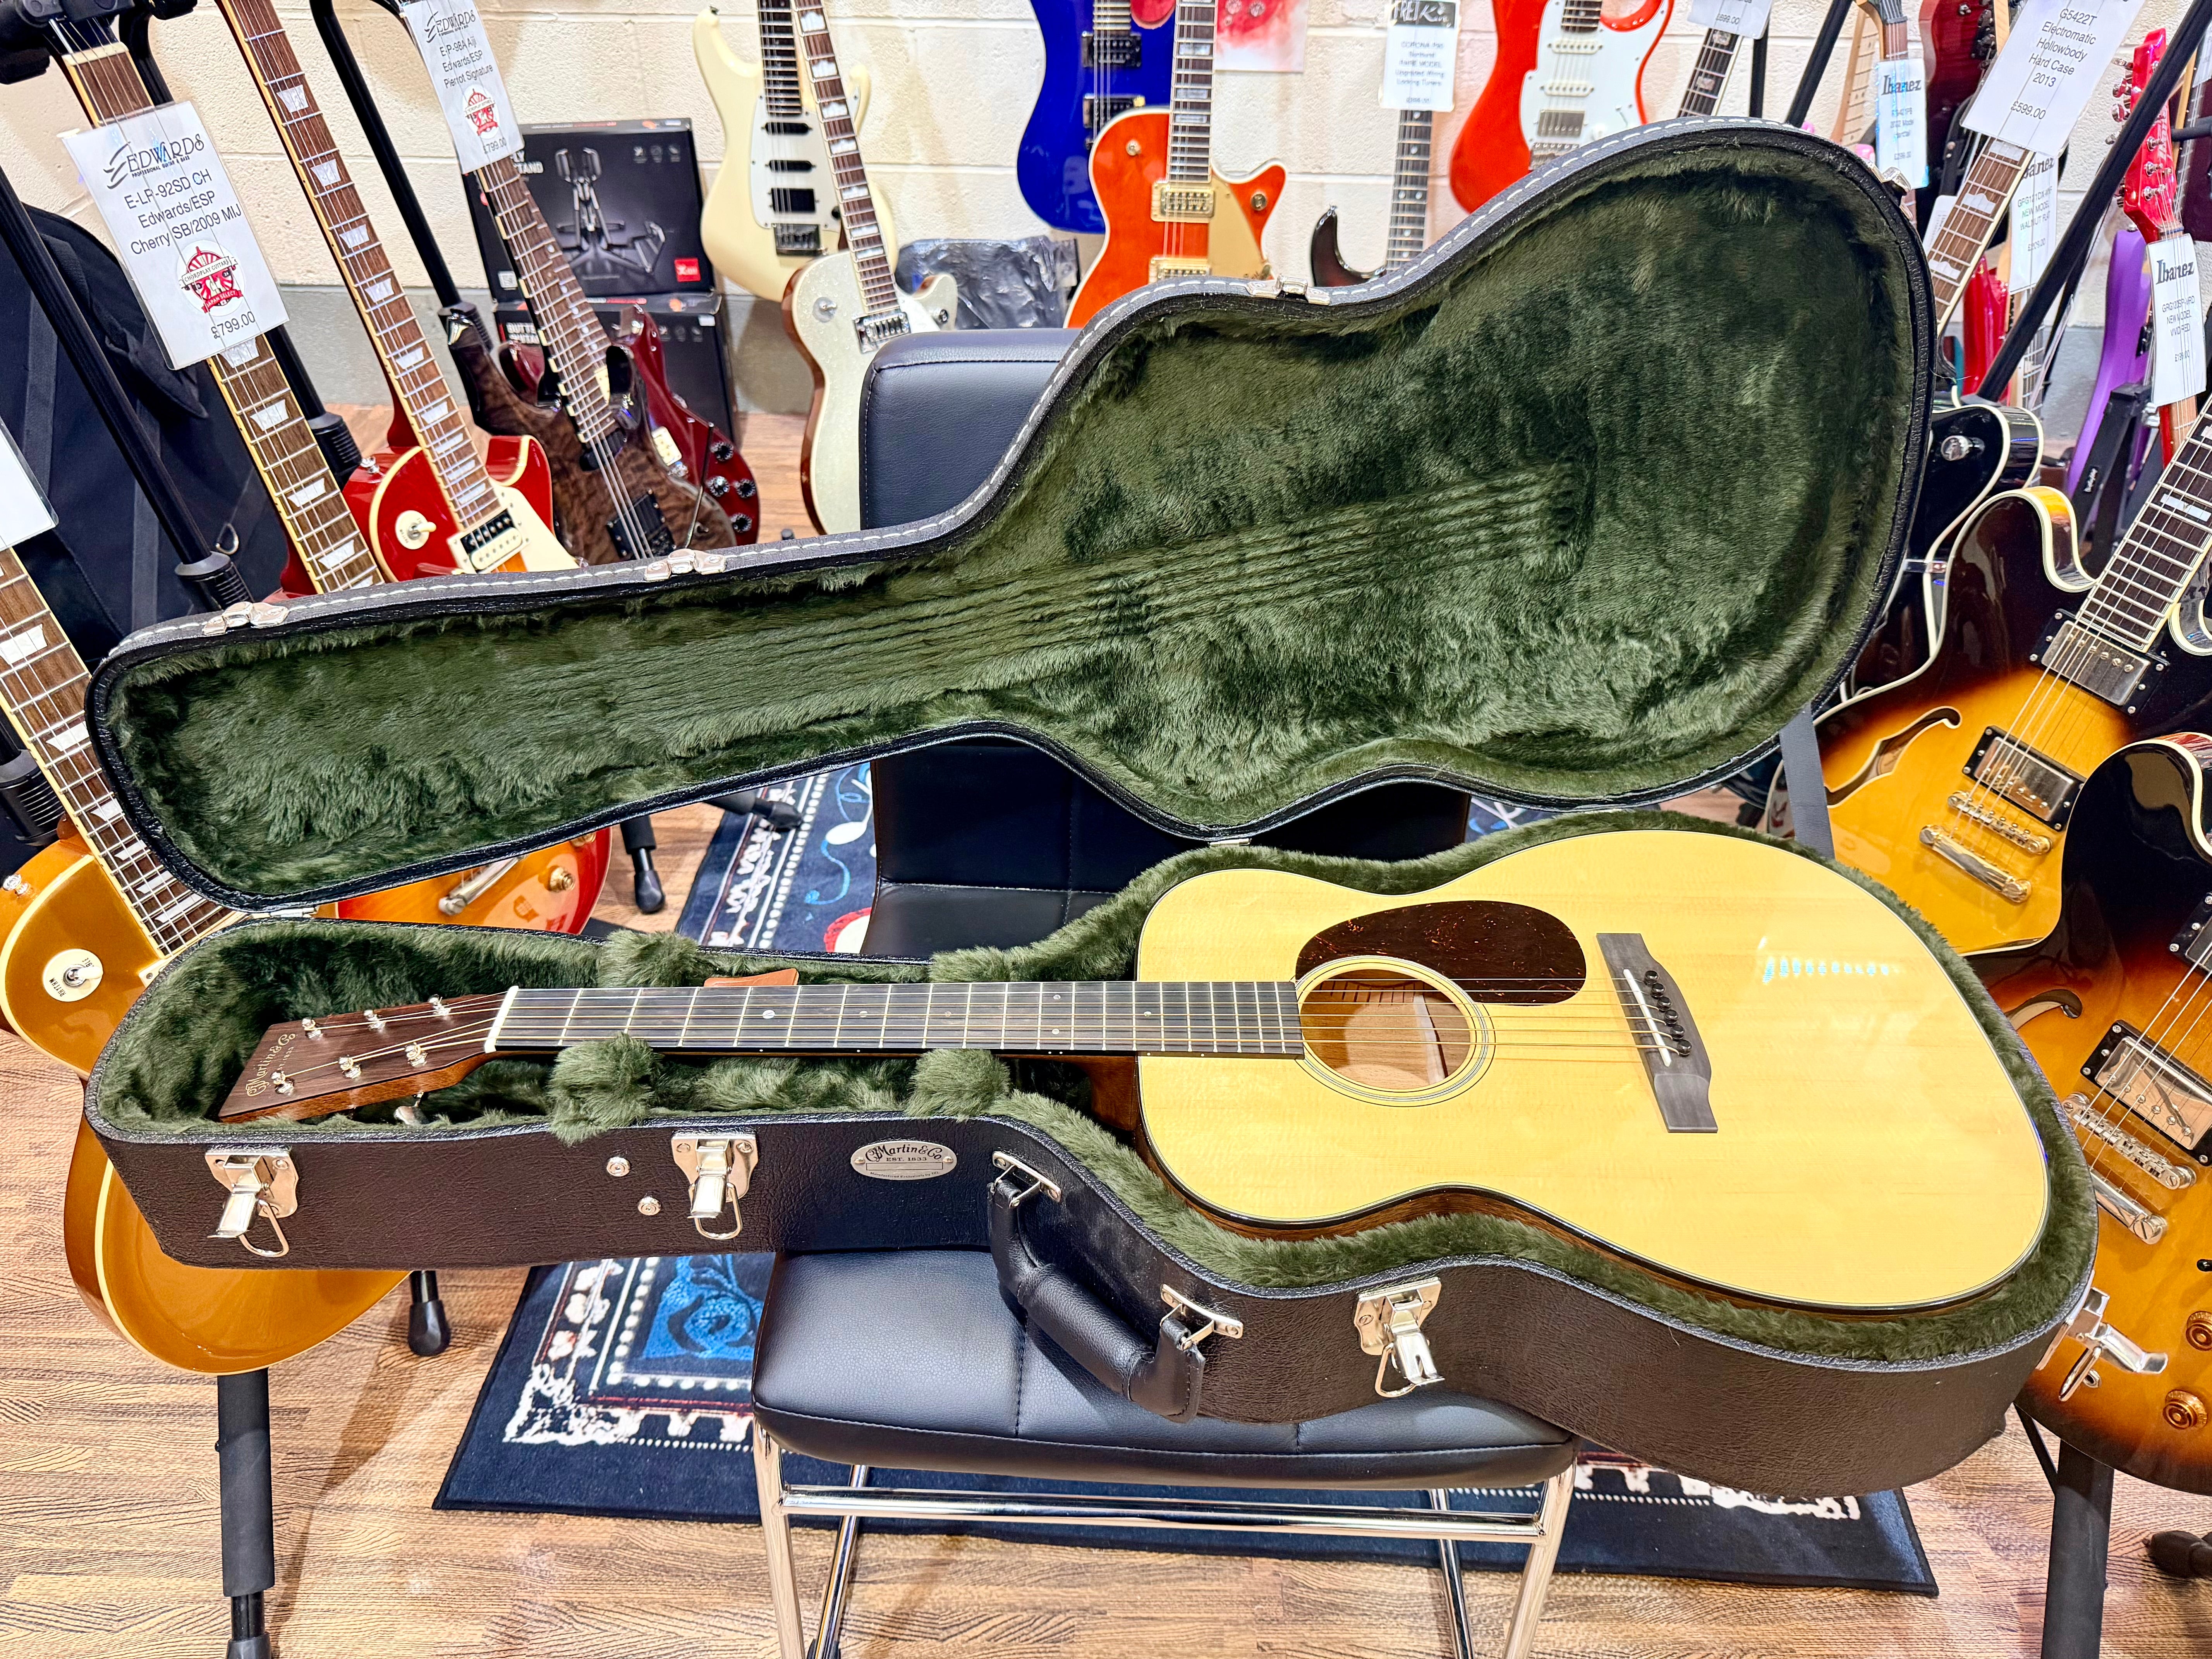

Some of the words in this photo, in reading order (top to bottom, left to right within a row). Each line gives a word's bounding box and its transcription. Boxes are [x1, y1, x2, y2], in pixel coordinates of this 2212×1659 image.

[436, 10, 476, 33] EDWARDS
[2060, 9, 2097, 26] G5422T
[2042, 21, 2096, 45] Electromatic
[2036, 37, 2088, 62] Hollowbody
[2028, 53, 2051, 67] Hard
[2051, 60, 2075, 75] Case
[444, 73, 466, 89] Pierrot
[465, 64, 493, 81] Signature
[1881, 75, 1922, 96] Ibanez
[2033, 72, 2056, 87] 2013
[2010, 100, 2046, 120] £599.00
[126, 134, 204, 172] EDWARDS
[132, 166, 160, 178] PROFESSIONAL
[192, 168, 212, 185] CH
[2022, 157, 2055, 180] banez
[138, 190, 215, 228] Edwards/ESP
[131, 233, 171, 254] Cherry
[172, 212, 220, 239] SB/2009
[222, 203, 242, 222] MIJ
[184, 267, 211, 282] CHORDPLAY
[2155, 259, 2194, 285] Ibanez
[206, 297, 220, 307] JAPAN
[220, 291, 236, 300] SELECT
[211, 311, 255, 339] £799.00
[49, 977, 66, 997] RHYTHM
